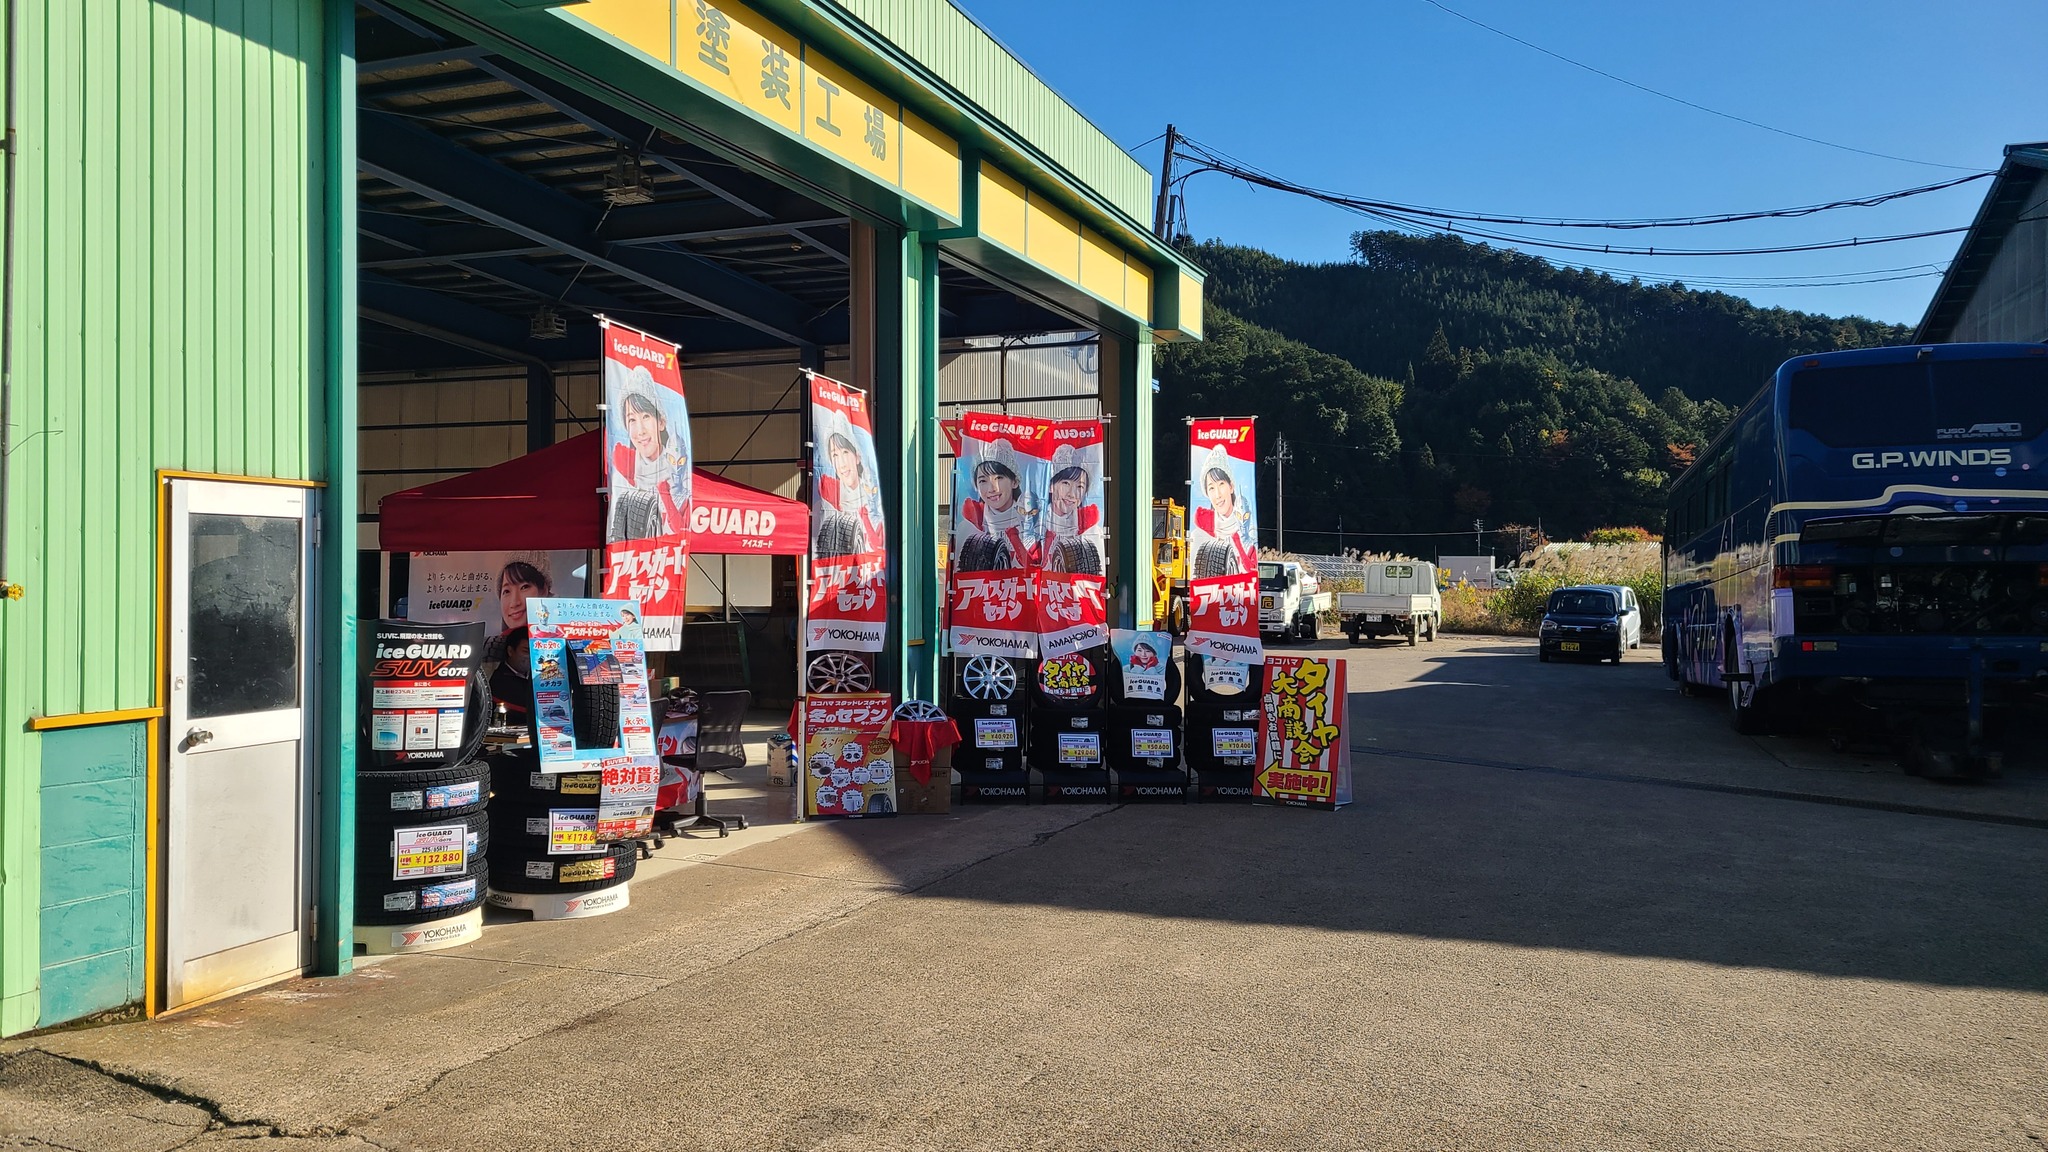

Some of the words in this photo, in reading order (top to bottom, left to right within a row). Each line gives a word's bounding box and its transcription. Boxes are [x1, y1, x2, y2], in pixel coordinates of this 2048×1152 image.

[696, 0, 886, 161] 塗装工場
[613, 338, 665, 365] iceGUARD
[666, 352, 676, 370] 7
[819, 386, 860, 407] iceGUARD
[970, 420, 1035, 436] iceGUARD
[1034, 425, 1049, 440] 7
[1197, 428, 1239, 440] iceGUARD
[1238, 426, 1251, 442] 7
[1852, 448, 2012, 469] G.P.WINDS
[741, 539, 774, 548] アイスガード
[606, 539, 687, 596] アイスガード
[812, 556, 886, 602] アイスガード
[836, 587, 877, 612] セブン
[954, 572, 1038, 611] アイスガード
[1193, 576, 1257, 616] アイスガード
[428, 600, 472, 610] iceGUARD
[1262, 597, 1274, 609] 危
[983, 601, 1023, 622] セブン
[1219, 604, 1249, 627] セブン
[828, 628, 880, 641] YOKOHAMA
[376, 643, 472, 659] iceGUARD
[534, 640, 561, 650] 氷に効く
[615, 640, 640, 650] 雪に効く
[976, 636, 1030, 650] YOKOHAMA
[1209, 639, 1258, 655] YOKOHAMA
[369, 660, 453, 677] SUV
[437, 667, 469, 677] G075
[1043, 660, 1087, 679] タイヤ
[1266, 657, 1299, 666] ヨコハマ
[1294, 658, 1340, 747] タイヤ
[808, 704, 888, 724] 冬のセブン
[1272, 671, 1322, 763] 大商談会
[406, 751, 445, 760] YOKOHAMA
[449, 789, 477, 799] iceGUARD
[979, 787, 1026, 796] YOKOHAMA
[1060, 787, 1107, 795] YOKOHAMA
[1136, 787, 1183, 795] YOKOHAMA
[416, 830, 453, 838] iceGUARD
[562, 869, 595, 877] iceGUARD
[444, 887, 473, 898] iceGUARD
[582, 893, 619, 906] YOKOHAMA
[422, 924, 467, 938] YOKOHAMA
